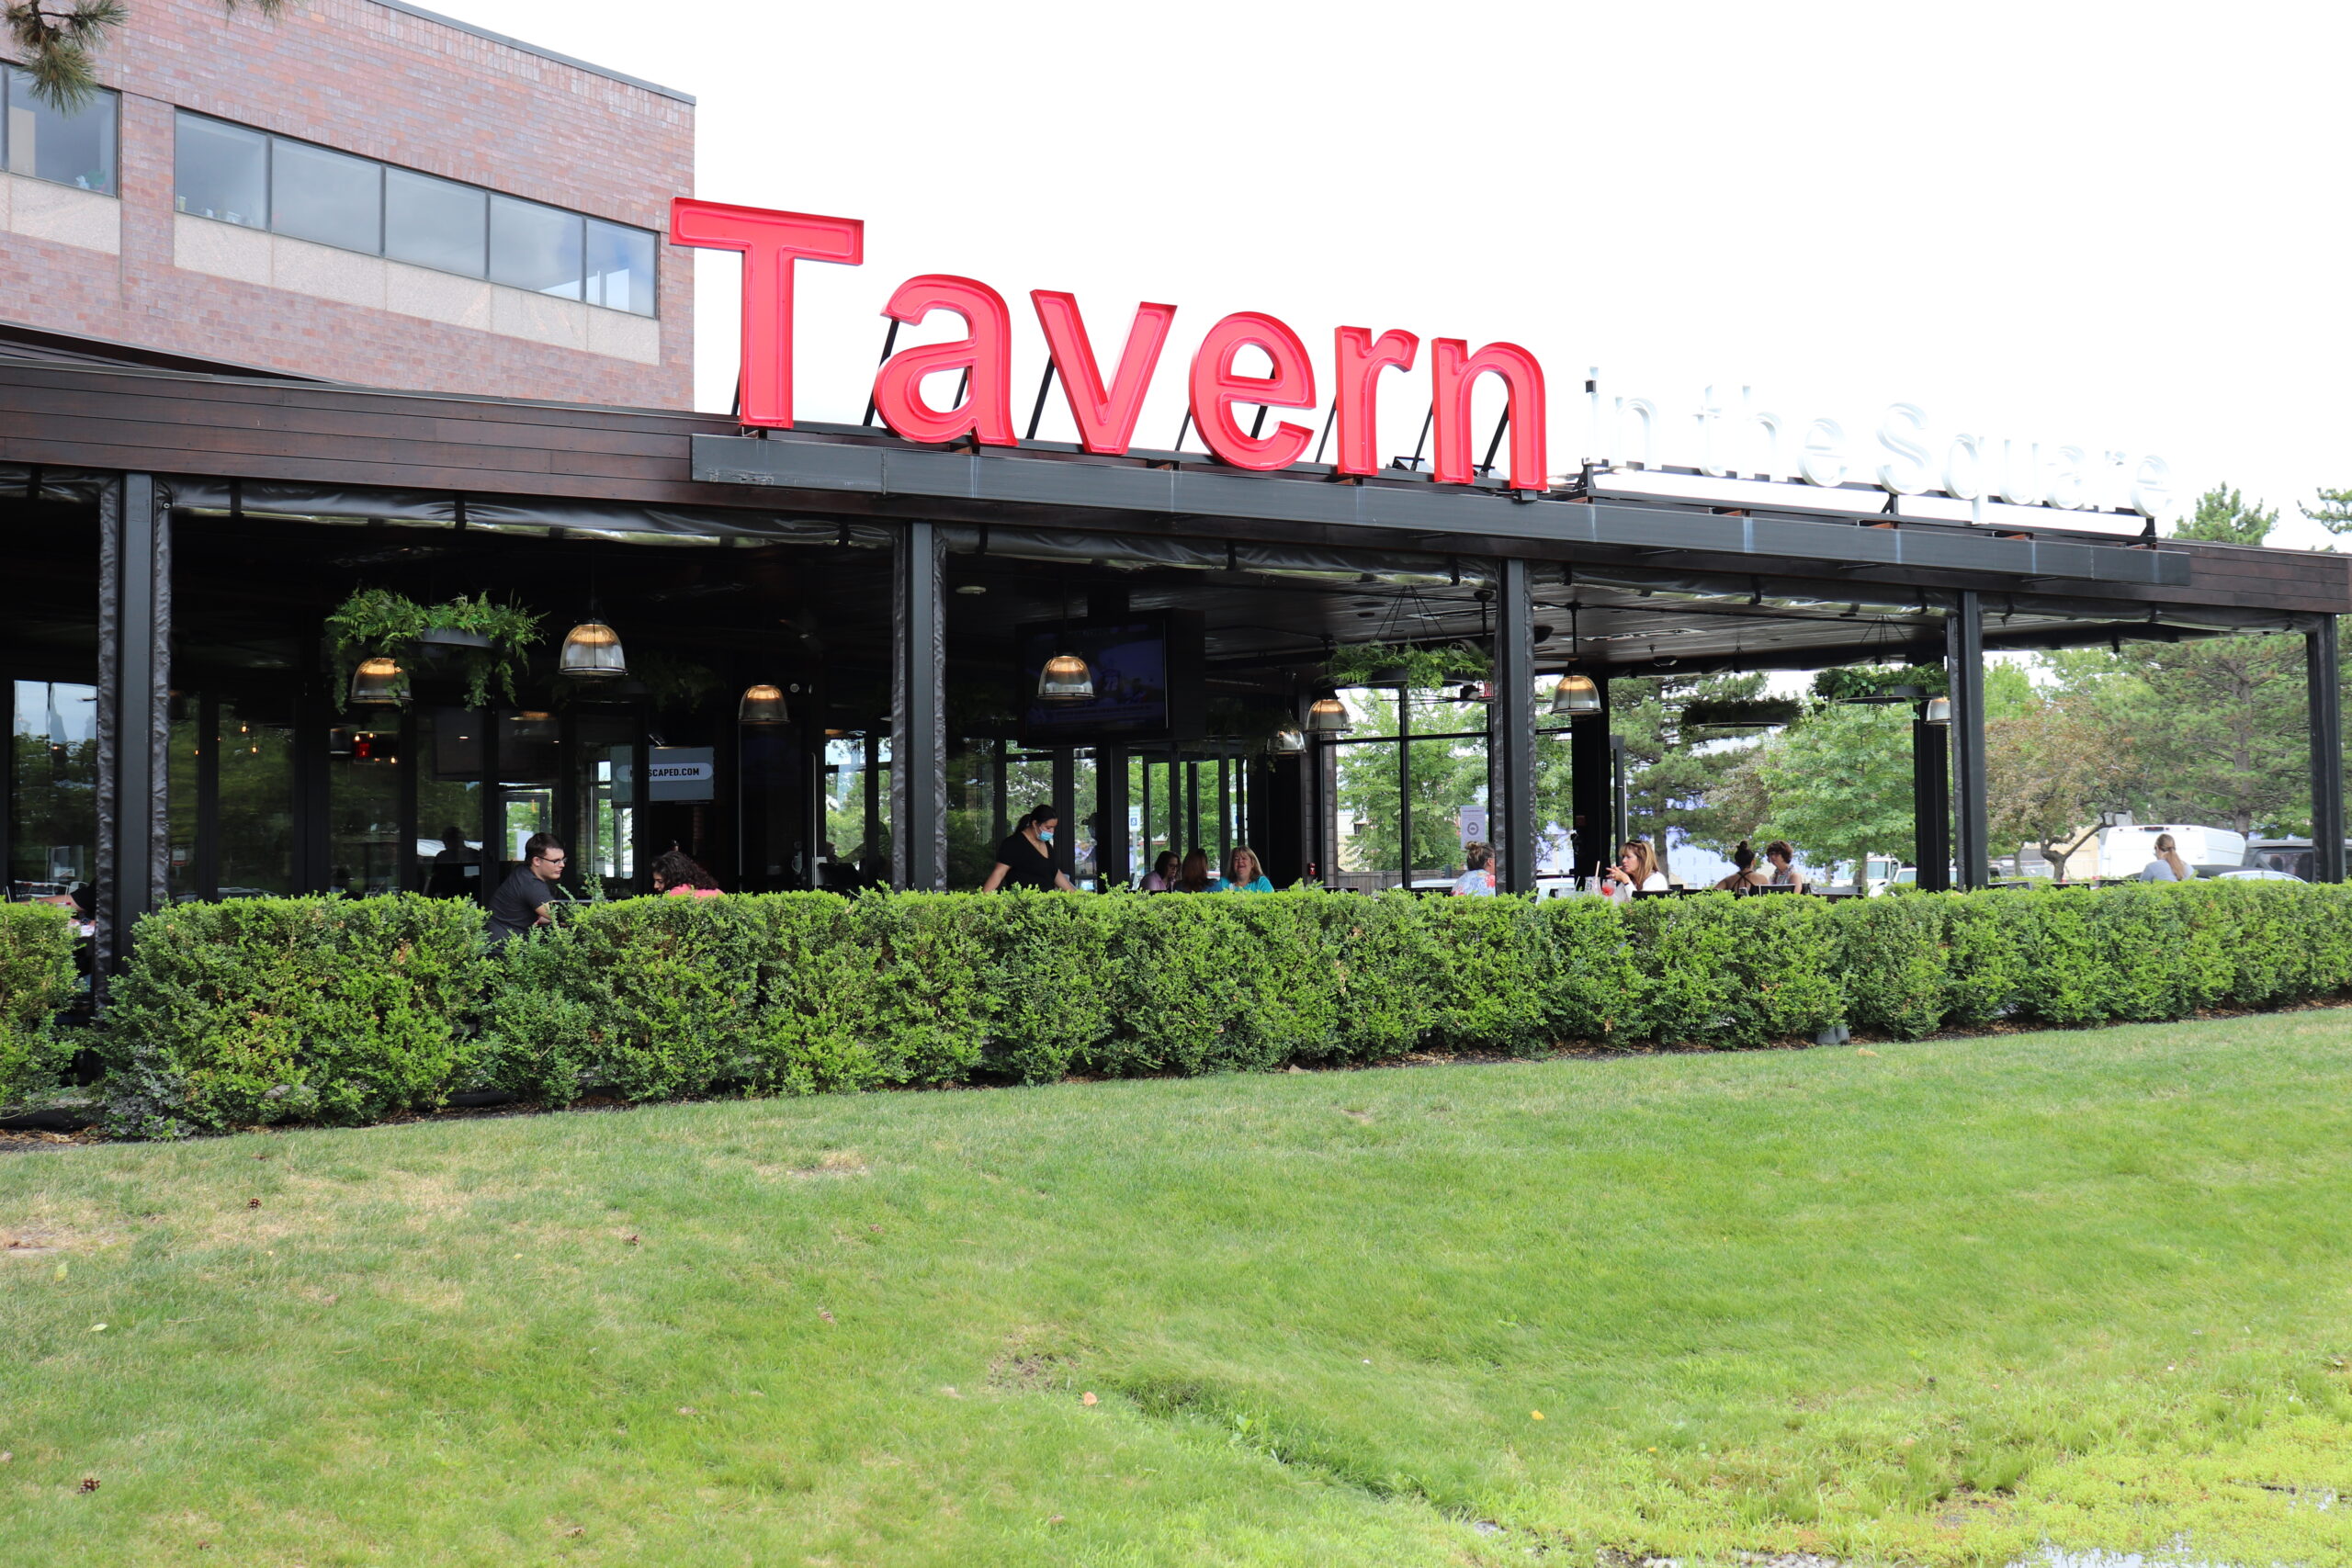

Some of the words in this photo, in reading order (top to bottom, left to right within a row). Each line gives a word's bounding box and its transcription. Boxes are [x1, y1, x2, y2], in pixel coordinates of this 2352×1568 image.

[670, 197, 1548, 491] Tavern
[1692, 384, 1847, 488] the
[1875, 401, 2172, 525] Square
[629, 768, 700, 777] SCAPED.COM
